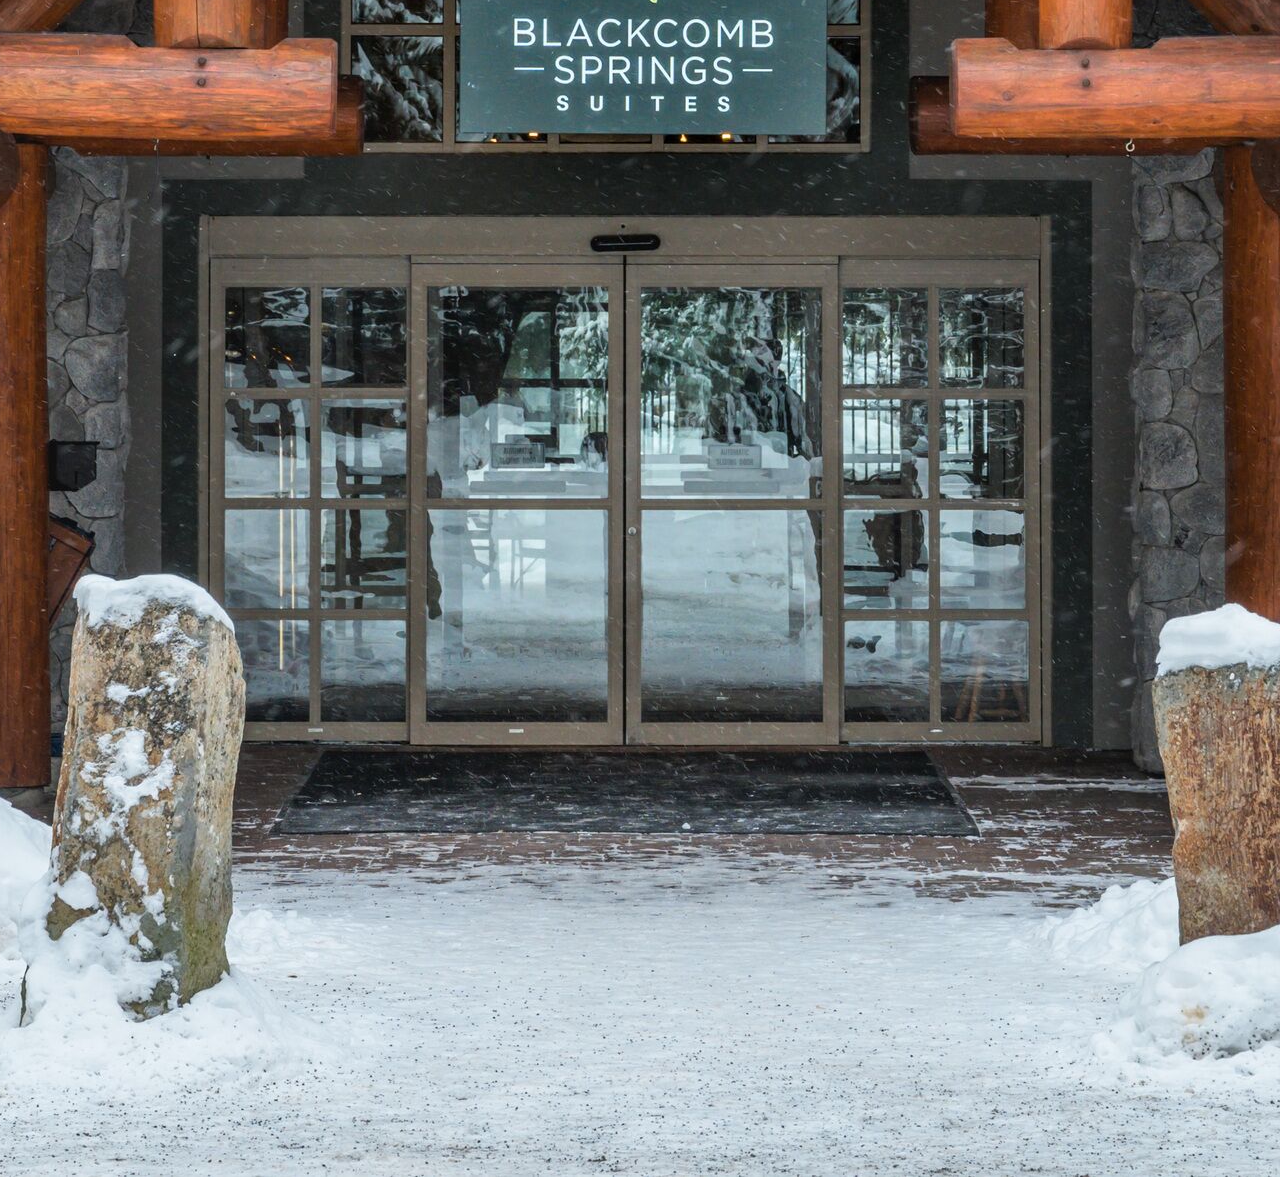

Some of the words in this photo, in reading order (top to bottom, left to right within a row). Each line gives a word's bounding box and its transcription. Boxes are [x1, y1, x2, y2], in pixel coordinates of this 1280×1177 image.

[513, 17, 775, 49] BLACKCOMB
[553, 54, 734, 86] SPRINGS
[556, 94, 731, 113] SUITES
